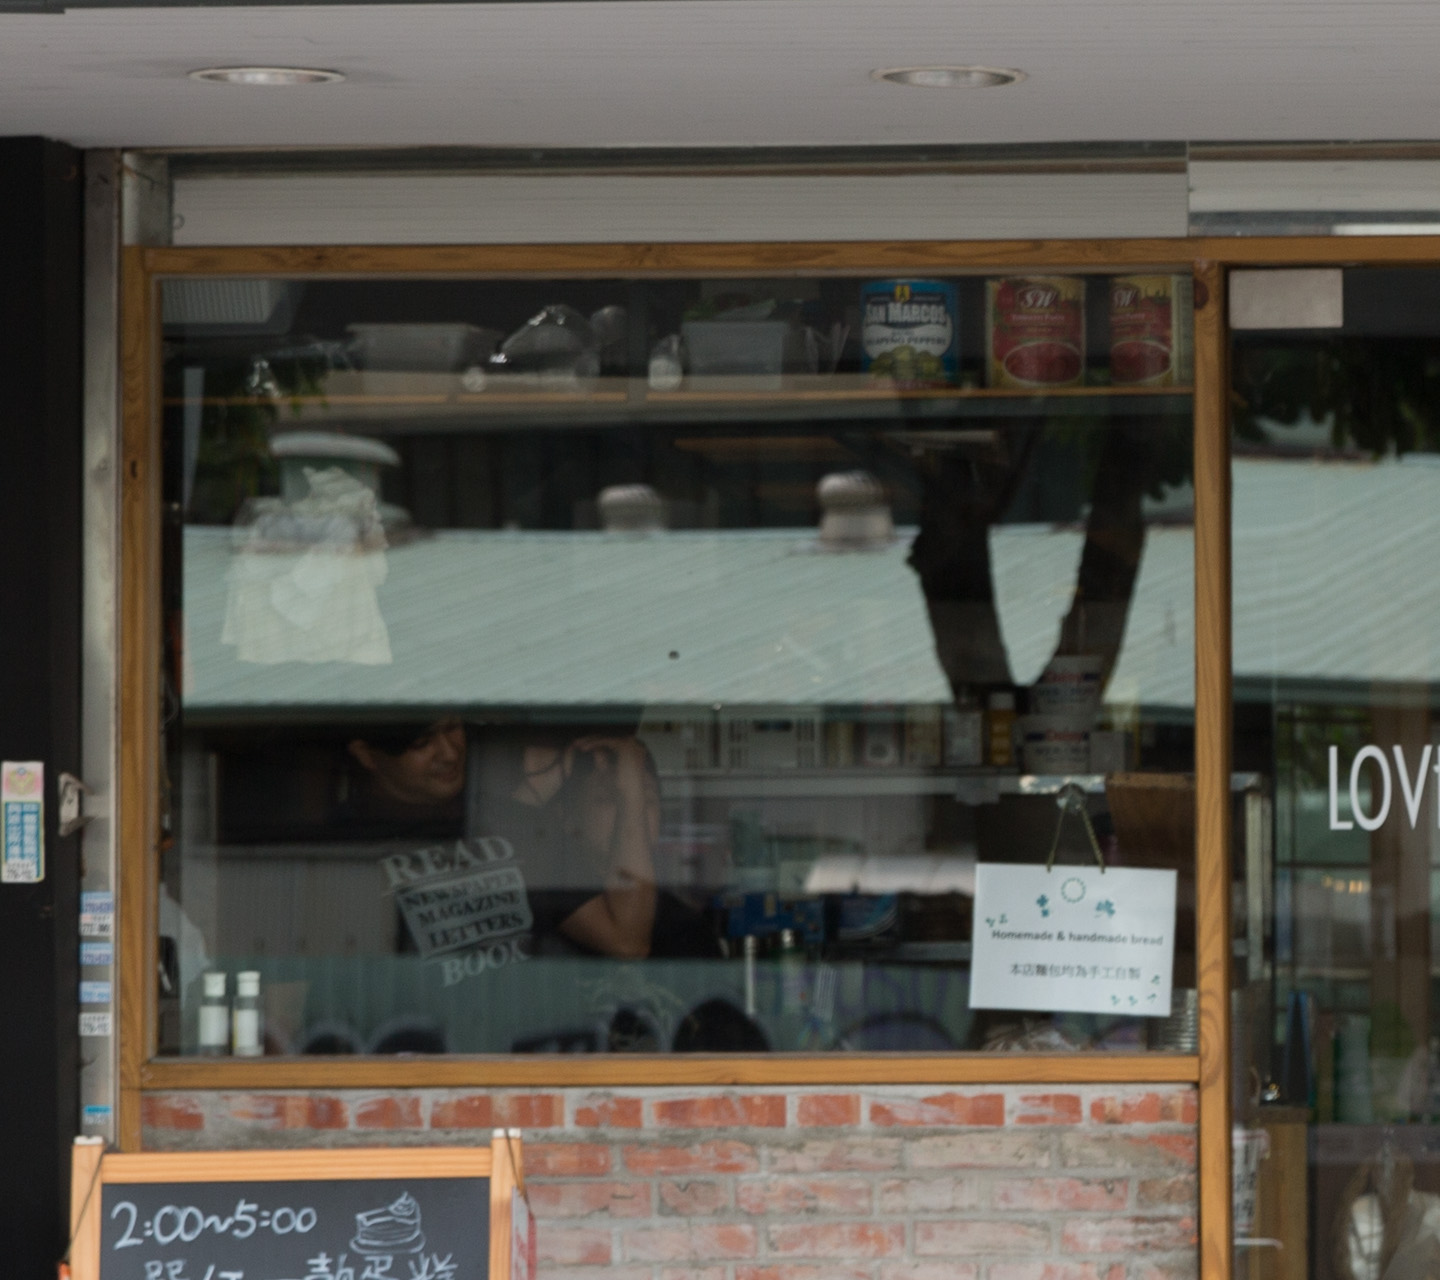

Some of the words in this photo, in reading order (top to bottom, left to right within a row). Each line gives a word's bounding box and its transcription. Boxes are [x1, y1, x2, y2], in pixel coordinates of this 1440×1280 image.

[381, 835, 515, 887] READ
[417, 890, 521, 925] MAGAZINE
[429, 911, 524, 948] LETTERS
[992, 929, 1054, 940] Homemade
[1056, 931, 1066, 941] &
[1069, 932, 1128, 944] handmade
[1131, 934, 1164, 946] bread
[1010, 963, 1142, 980] 本店麵包均為手工自製
